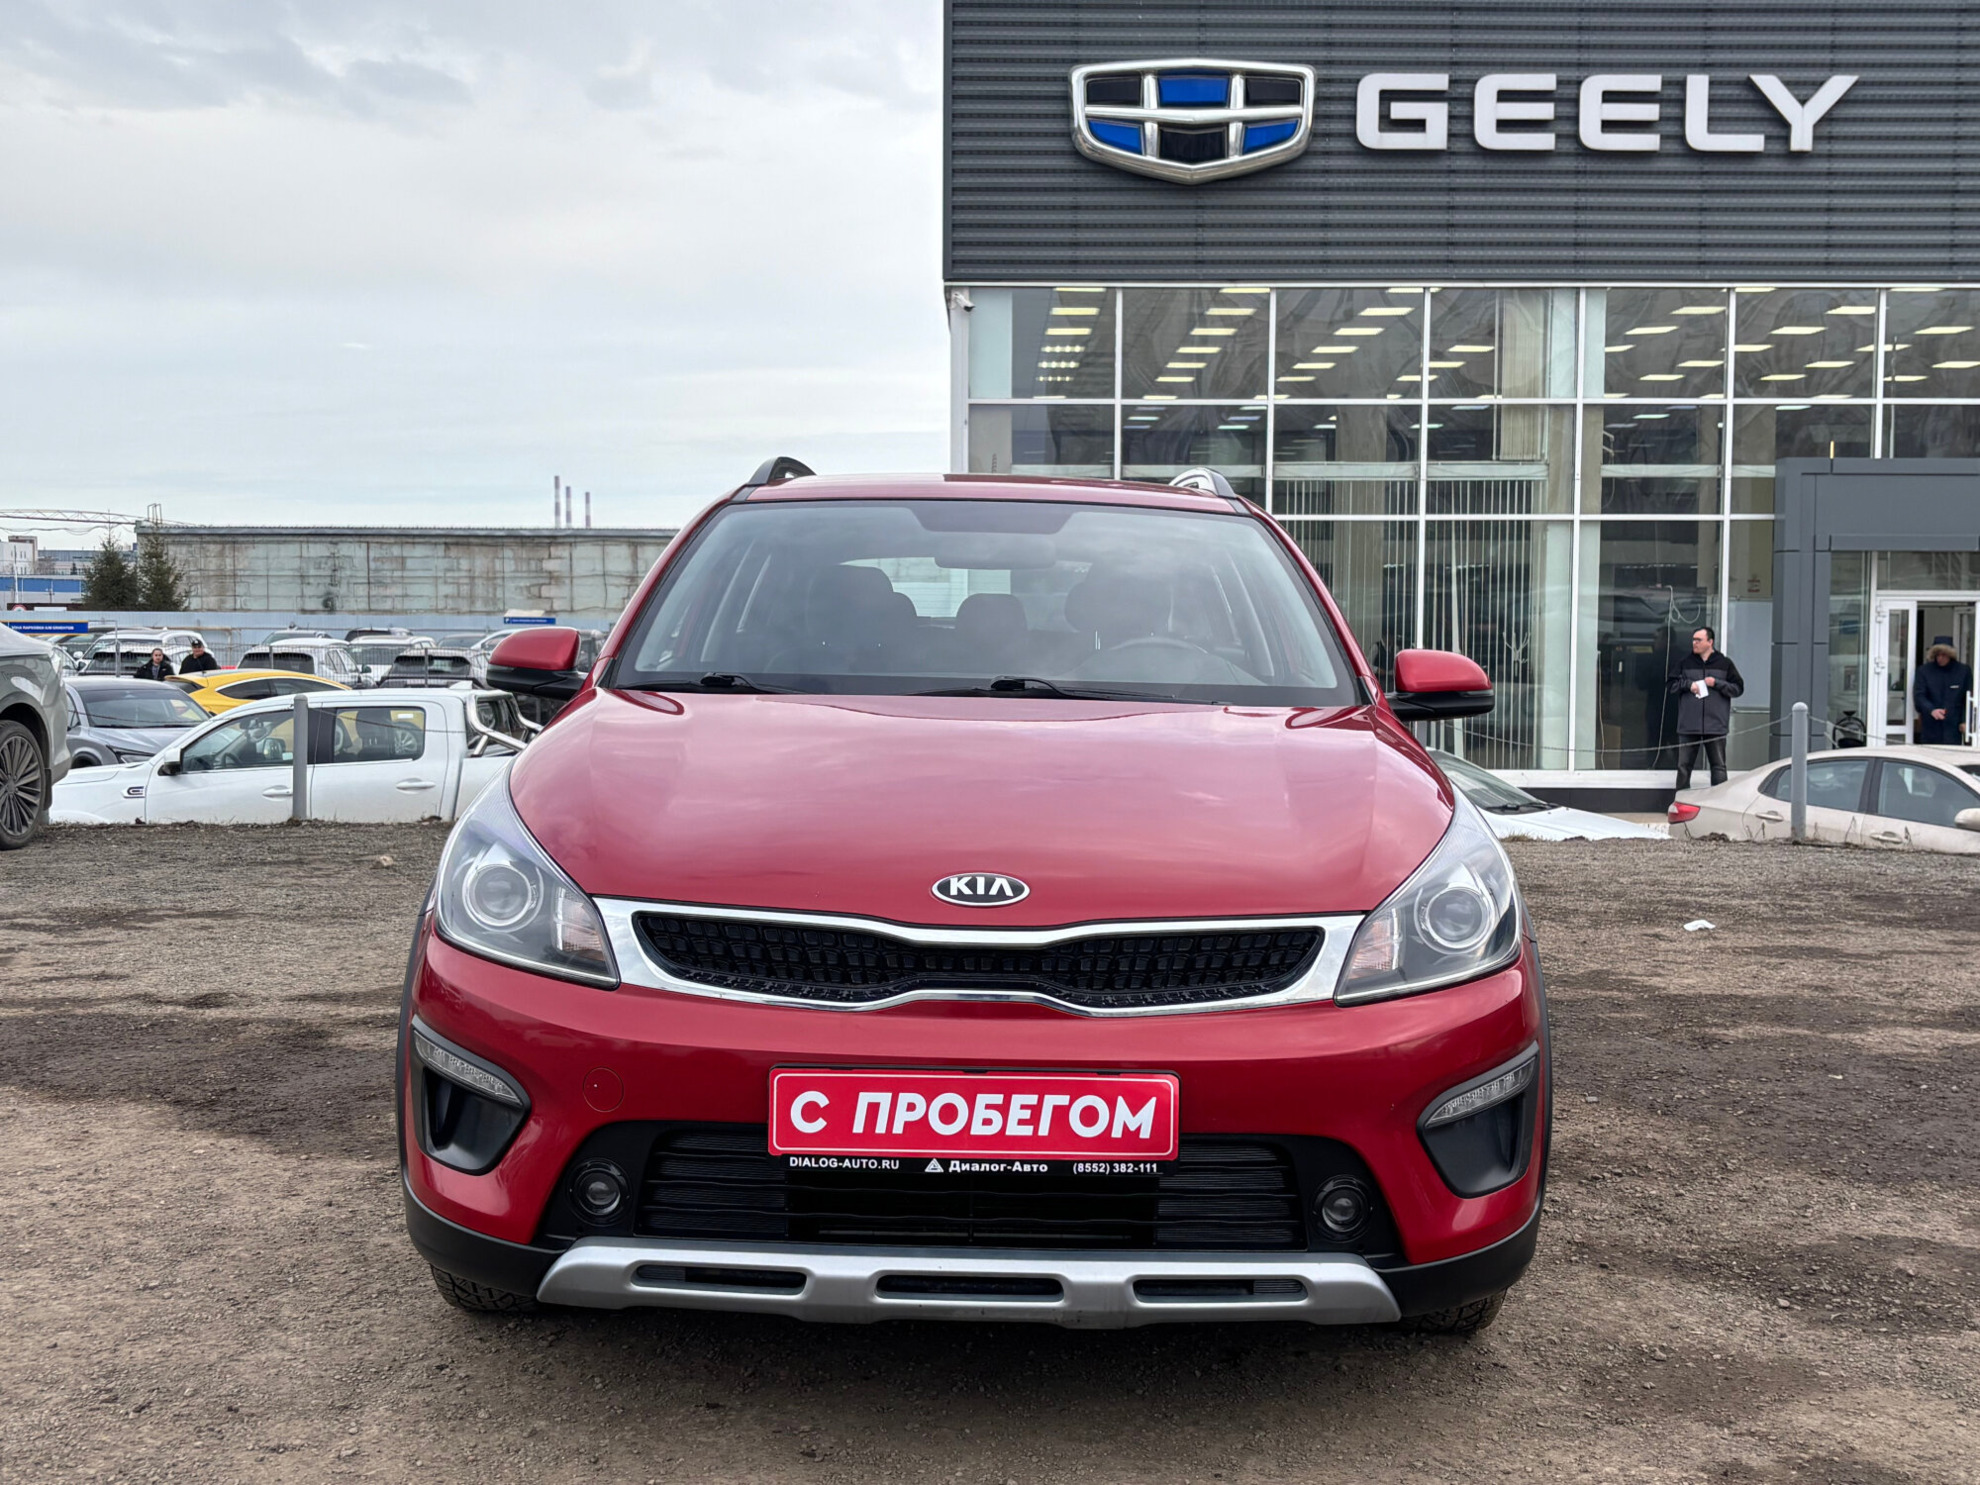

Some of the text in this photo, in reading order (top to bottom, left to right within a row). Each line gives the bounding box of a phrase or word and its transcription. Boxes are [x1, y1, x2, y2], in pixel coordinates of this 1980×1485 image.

[1356, 73, 1860, 151] GEELY
[949, 876, 1014, 897] KIA
[790, 1090, 1157, 1139] С ПРОБЕГОМ
[789, 1156, 900, 1170] DIALOG-AUTO.RU
[949, 1160, 1048, 1173] Диалог-Авто
[1072, 1162, 1158, 1175] (8552) 382-111
